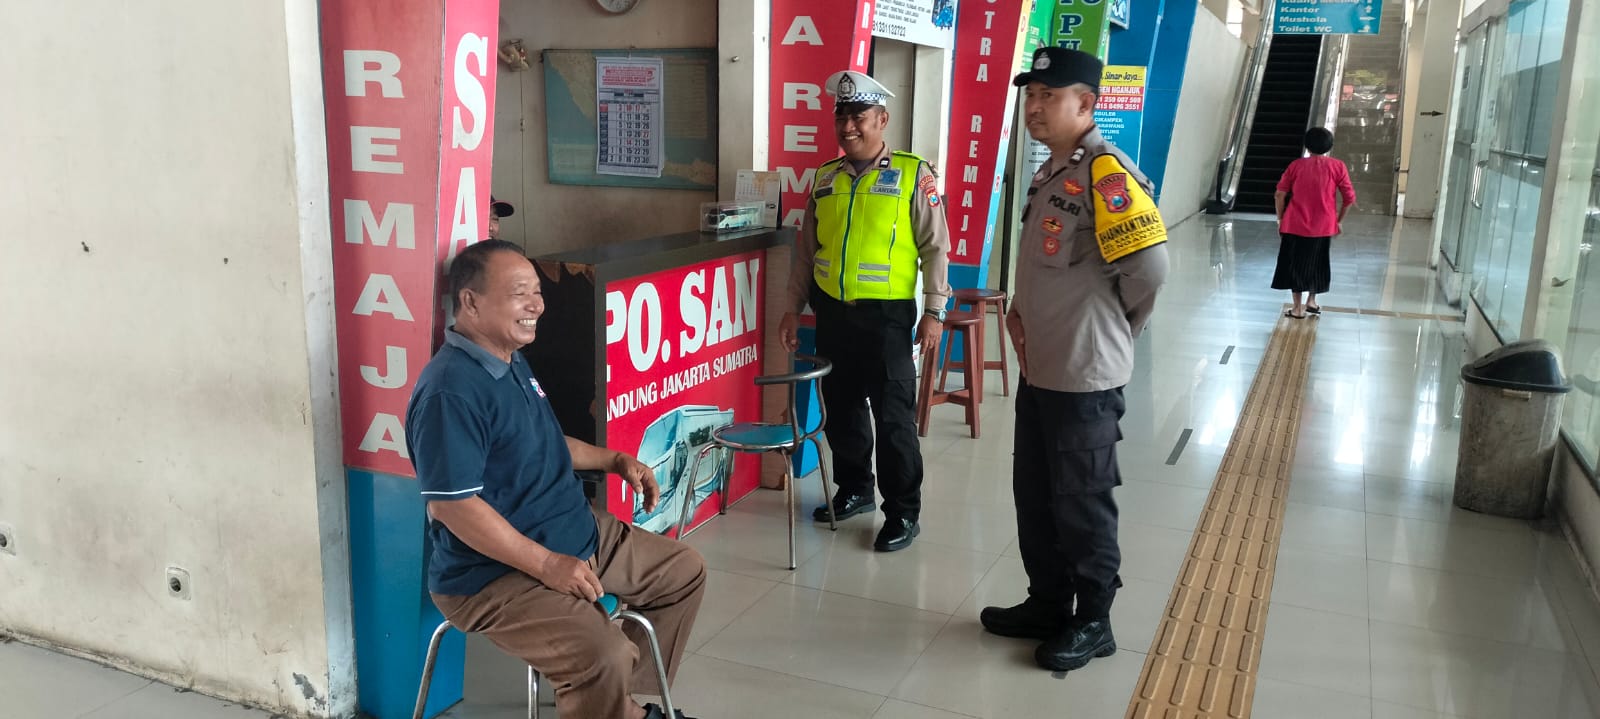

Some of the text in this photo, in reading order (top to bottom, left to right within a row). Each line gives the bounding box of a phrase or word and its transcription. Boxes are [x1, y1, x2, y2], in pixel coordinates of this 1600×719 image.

[976, 0, 996, 82] TRA
[1105, 72, 1122, 80] Sinar
[441, 32, 488, 322] SA
[956, 114, 983, 256] REMAJA
[1048, 194, 1081, 217] POLRI
[343, 49, 416, 459] REMAJA
[606, 258, 760, 382] PO. SAN
[660, 362, 711, 399] JAKARTA
[713, 343, 758, 378] SUMATRA
